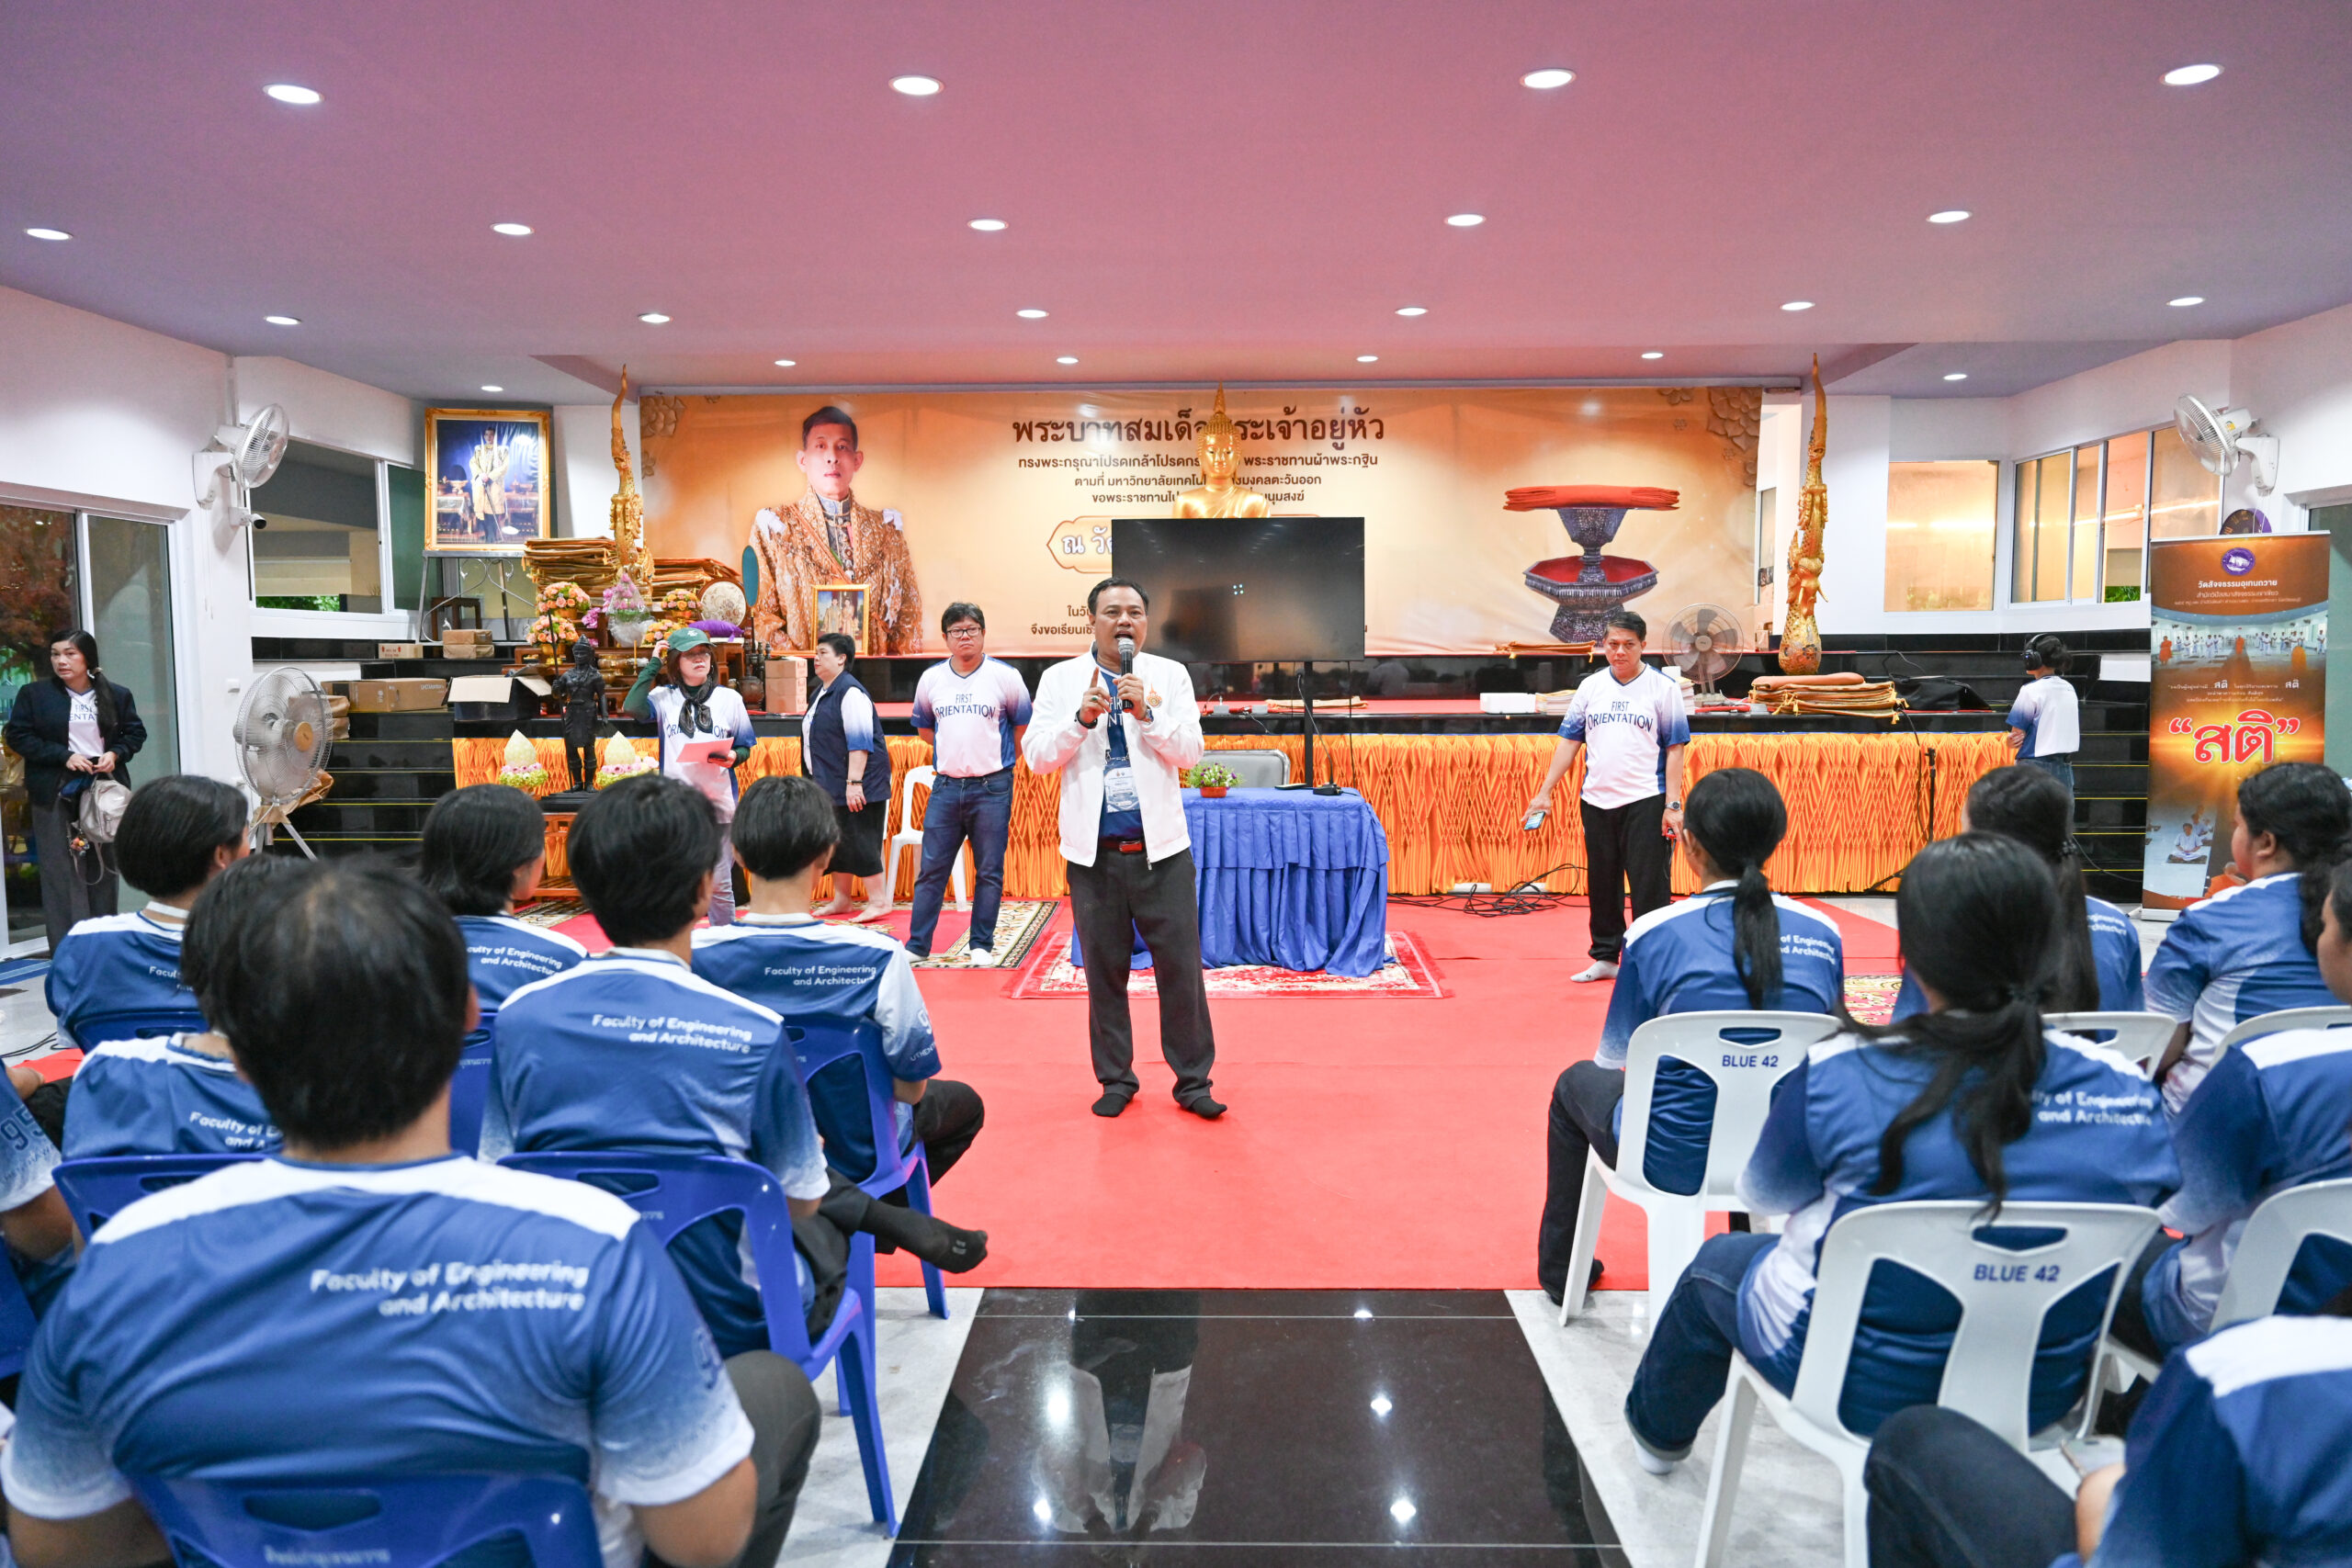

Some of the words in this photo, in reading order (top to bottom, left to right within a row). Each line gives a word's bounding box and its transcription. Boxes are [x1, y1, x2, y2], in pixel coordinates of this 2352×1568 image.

[1012, 405, 1384, 450] พระบาทสมเด็ระเจ้าอยู่หัว
[1075, 471, 1104, 486] ตามที่
[1062, 536, 1085, 554] ณ
[1031, 624, 1094, 636] จึงขอเรียนเชิ
[956, 694, 973, 704] FIRST
[1611, 701, 1630, 712] FIRST
[935, 704, 995, 720] ORIENTATION
[1588, 713, 1653, 732] ORIENTATION
[2169, 709, 2300, 763] “สติ”
[1780, 934, 1791, 942] of
[467, 946, 493, 955] culty
[494, 946, 506, 954] of
[507, 948, 563, 969] Engineering
[481, 956, 501, 964] and
[501, 958, 557, 976] Architectur
[764, 966, 802, 976] Faculty
[804, 965, 816, 975] of
[818, 964, 876, 976] Engineering
[793, 977, 812, 986] and
[592, 1014, 646, 1031] Faculty
[648, 1016, 665, 1029] of
[666, 1017, 752, 1043] Engineering
[628, 1032, 658, 1043] and
[658, 1032, 751, 1054] Architecture
[1722, 1055, 1757, 1067] BLUE
[1761, 1055, 1779, 1067] 42
[2054, 1090, 2073, 1105] of
[189, 1111, 246, 1134] Faculty
[2038, 1109, 2071, 1122] and
[310, 1269, 408, 1293] Faculty
[411, 1263, 442, 1286] of
[444, 1259, 590, 1289] Engineering
[1973, 1264, 2029, 1282] BLUE
[2033, 1265, 2060, 1282] 42
[379, 1292, 429, 1316] and
[430, 1287, 586, 1314] Architecture
